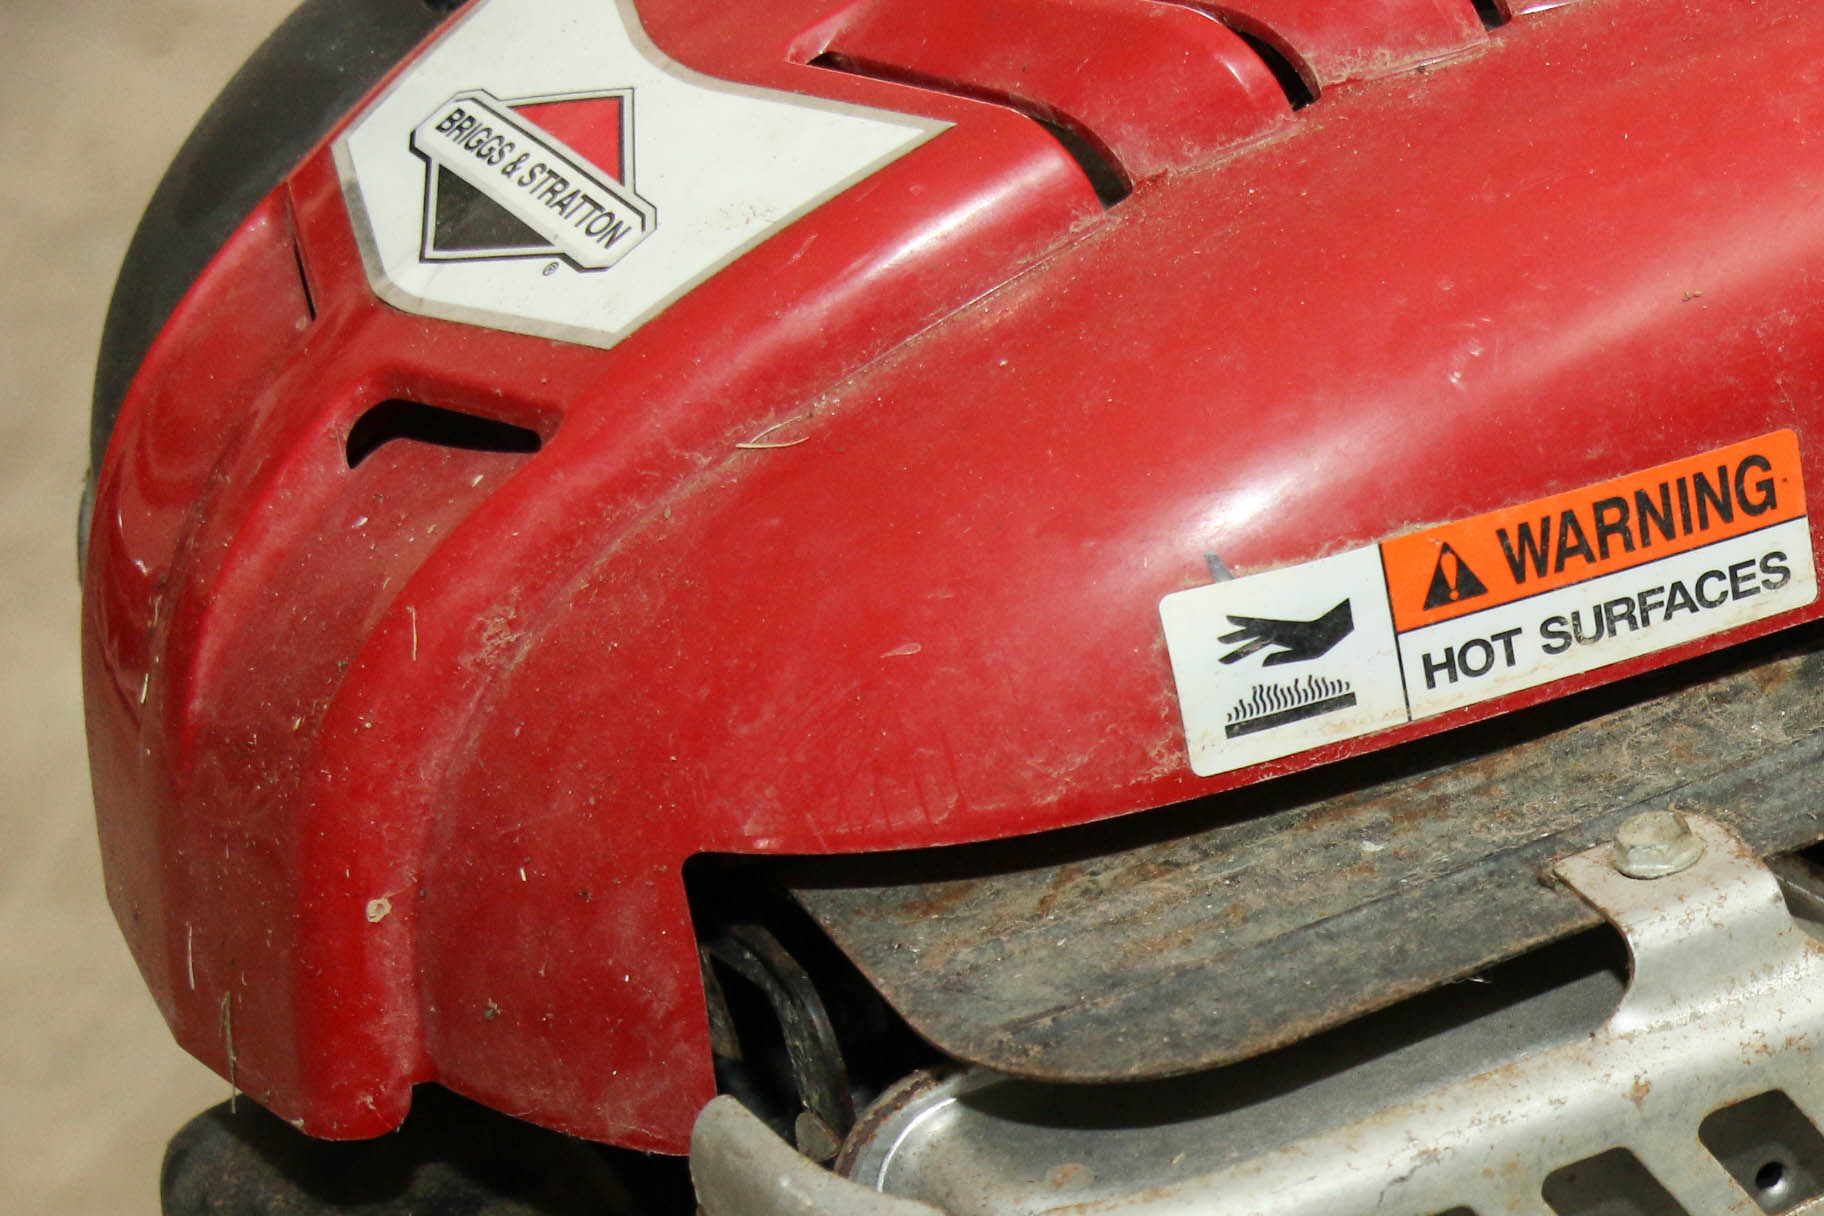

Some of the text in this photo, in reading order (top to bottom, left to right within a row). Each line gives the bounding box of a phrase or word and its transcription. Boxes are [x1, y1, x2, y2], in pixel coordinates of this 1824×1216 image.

[435, 108, 632, 249] BRIGGS & STRATTON
[1497, 454, 1778, 585] WARNING
[1421, 551, 1792, 690] HOT SURFACES
